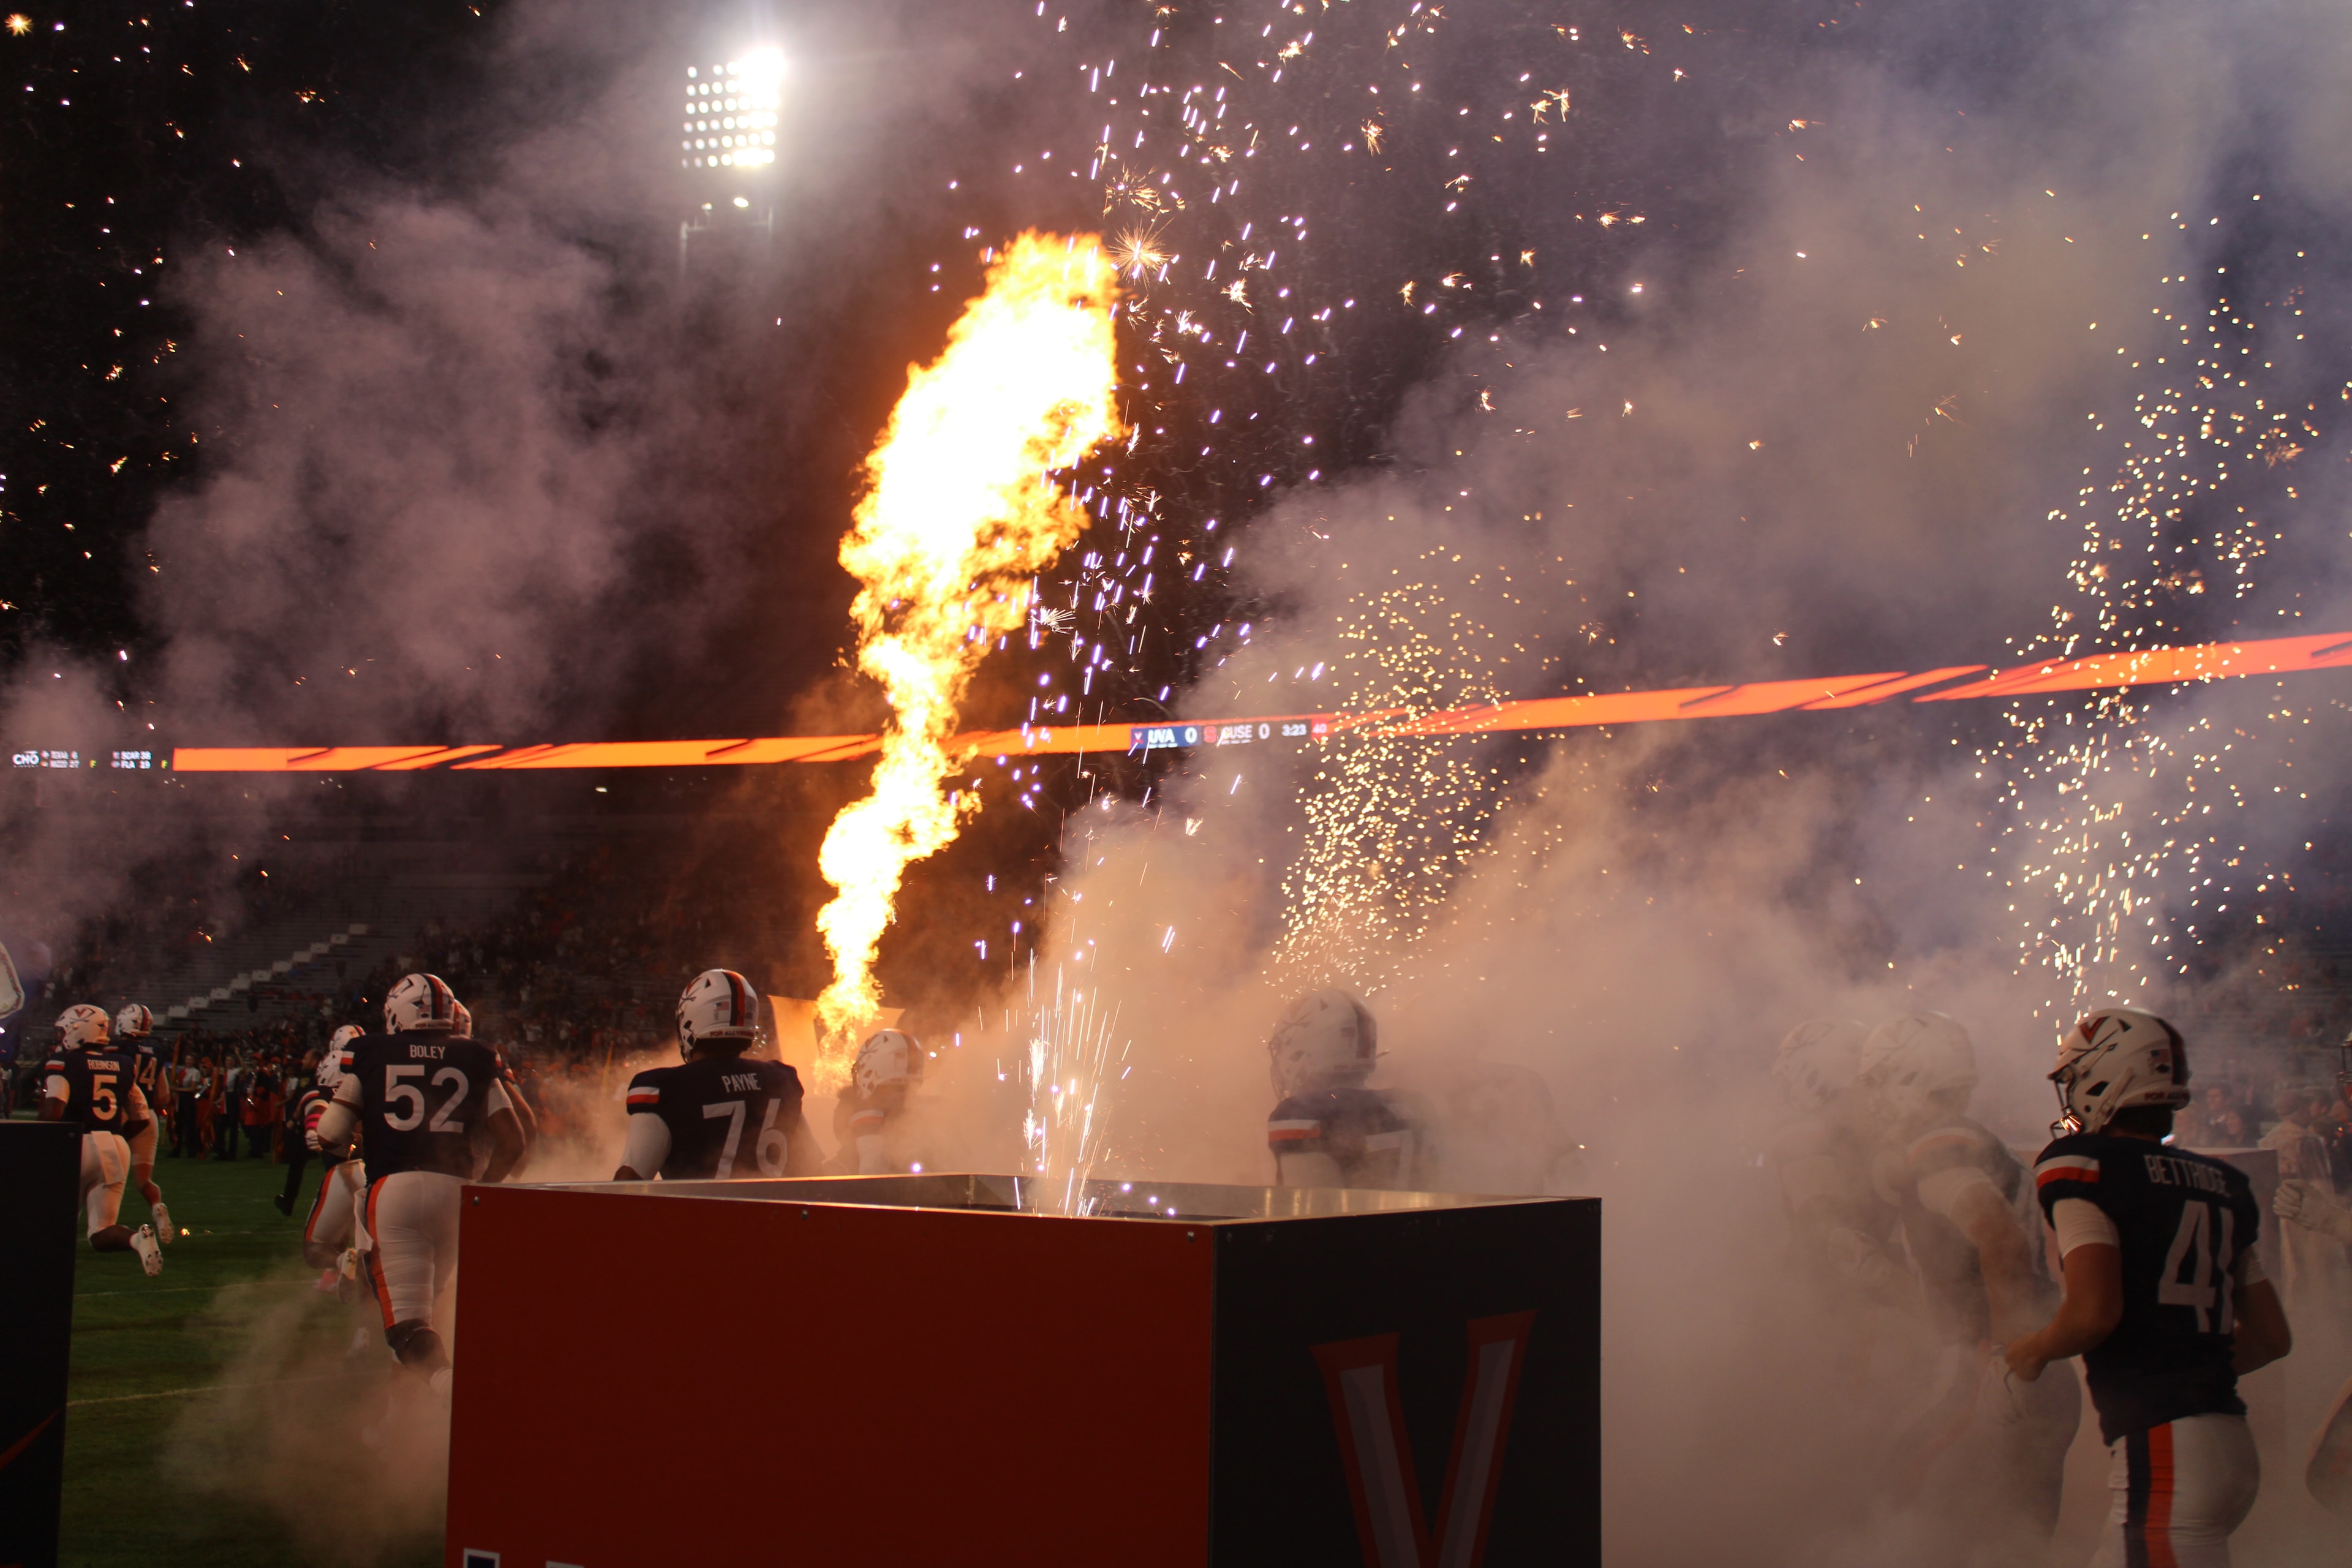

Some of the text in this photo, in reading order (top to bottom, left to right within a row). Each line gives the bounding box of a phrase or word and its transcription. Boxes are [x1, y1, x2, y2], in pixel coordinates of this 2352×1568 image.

[1148, 727, 1197, 744] UVA 0
[1258, 723, 1270, 740] 0
[12, 753, 40, 766] CHO
[86, 1059, 121, 1071] ROBINSON
[409, 1044, 445, 1059] BOLEY
[134, 1053, 158, 1091] 14
[721, 1073, 762, 1093] PAYNE
[92, 1074, 118, 1121] 5
[383, 1065, 469, 1133] 52
[702, 1098, 788, 1180] 76
[2157, 1199, 2235, 1335] 41
[1307, 1310, 1540, 1568] V
